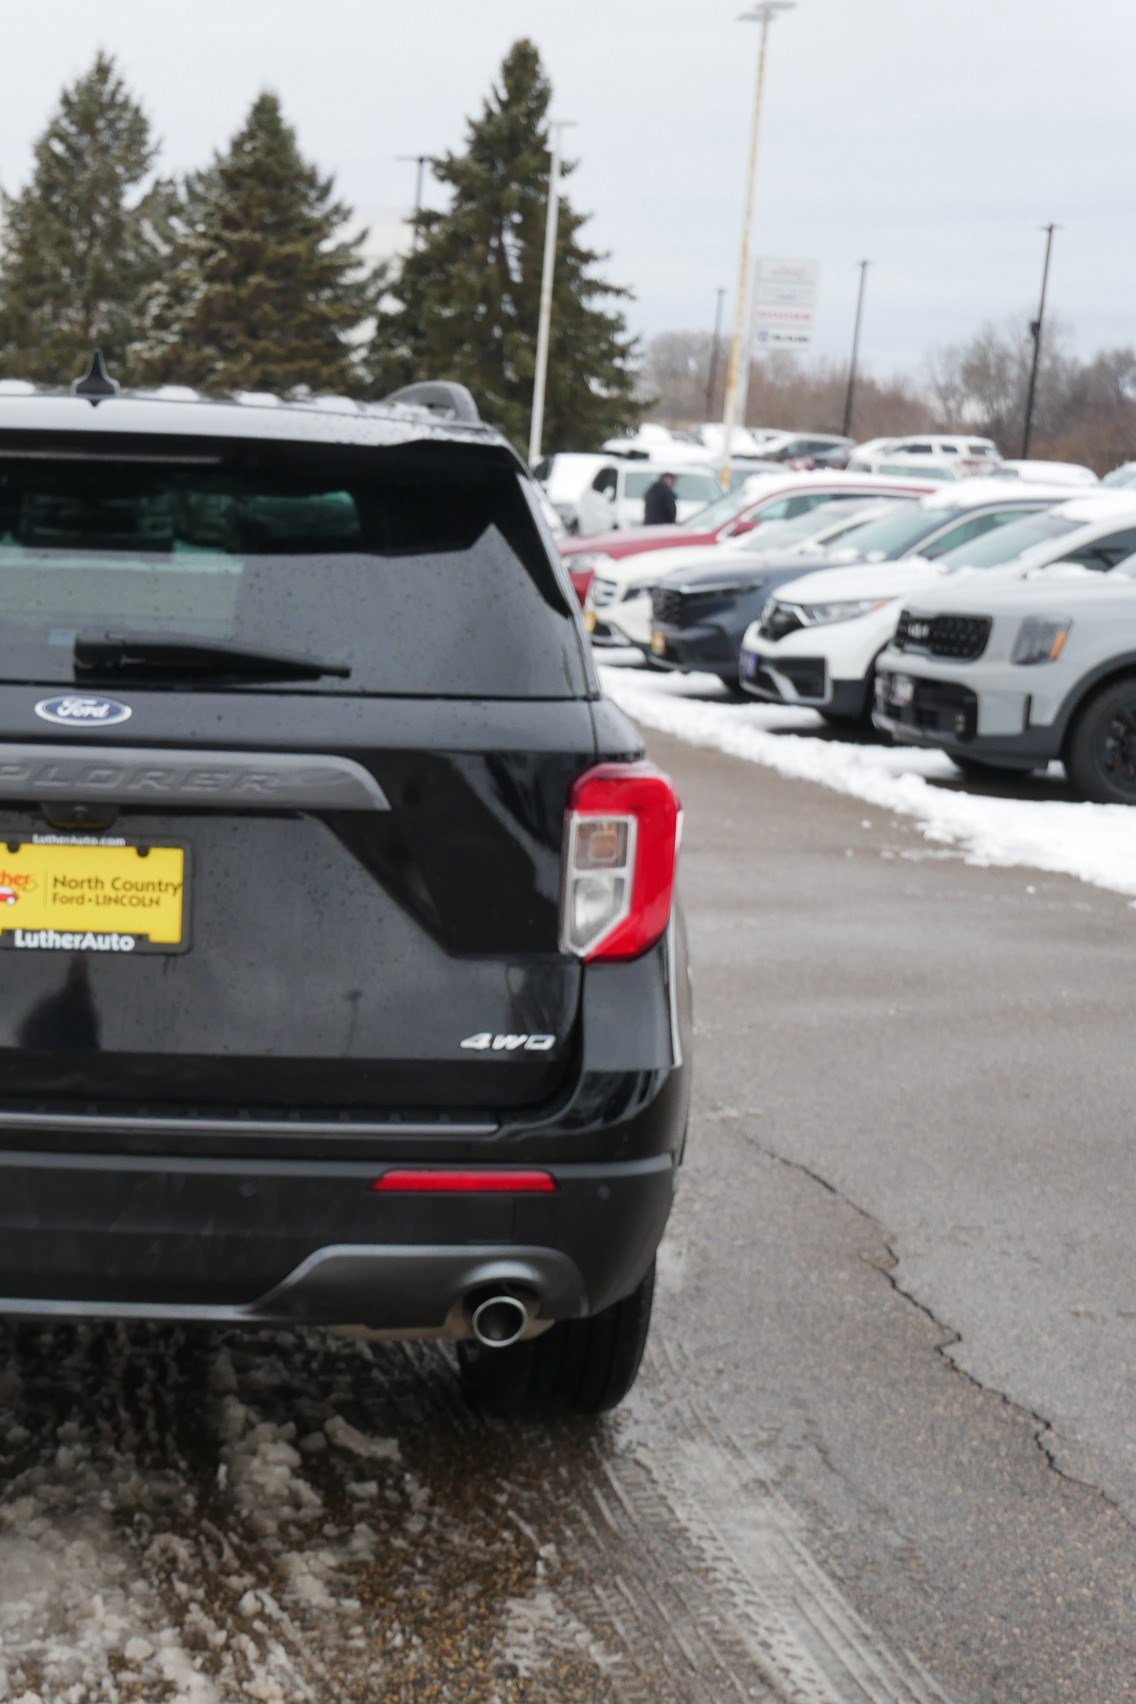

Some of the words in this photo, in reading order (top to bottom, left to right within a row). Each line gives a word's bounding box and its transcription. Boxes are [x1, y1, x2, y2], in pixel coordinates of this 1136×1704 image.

[56, 697, 111, 719] Ford
[32, 834, 126, 847] LutherAuto.com
[52, 875, 105, 891] North
[111, 877, 183, 896] Country
[52, 893, 85, 906] Ford
[95, 895, 161, 908] LINCOLN
[14, 929, 135, 951] LutherAuto
[460, 1032, 556, 1051] 4WD
